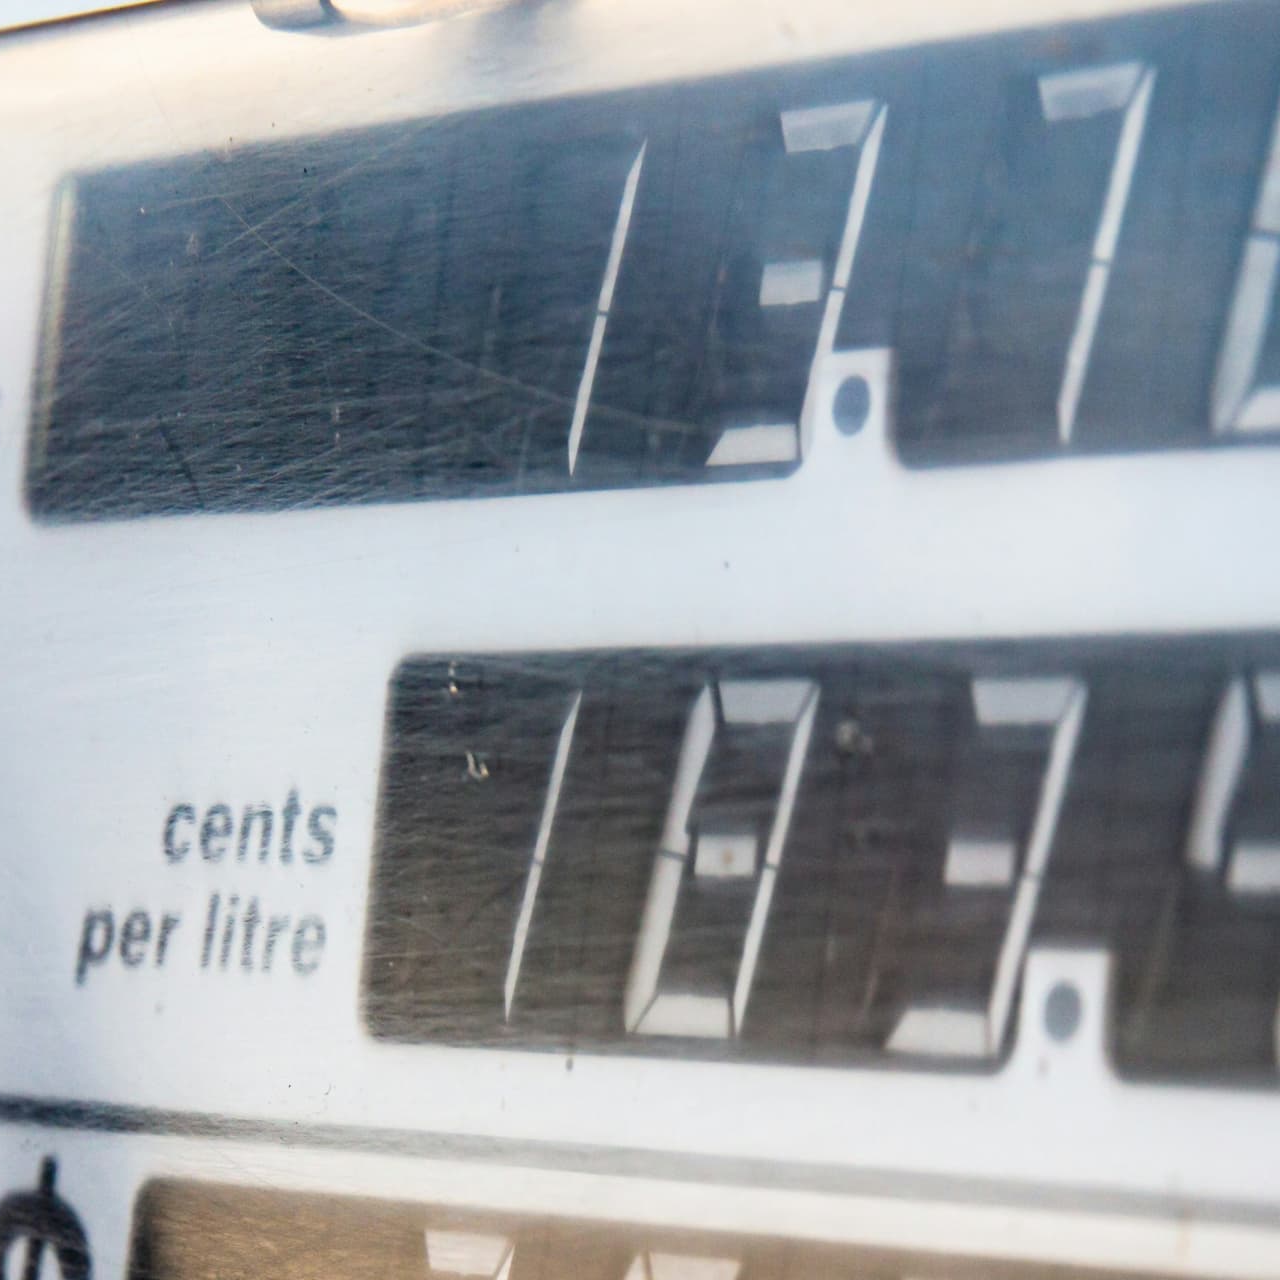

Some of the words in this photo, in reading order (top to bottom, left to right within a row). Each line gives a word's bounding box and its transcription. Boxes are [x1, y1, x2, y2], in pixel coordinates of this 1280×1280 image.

[162, 783, 338, 863] cents
[75, 903, 181, 988] per
[200, 890, 327, 974] litre
